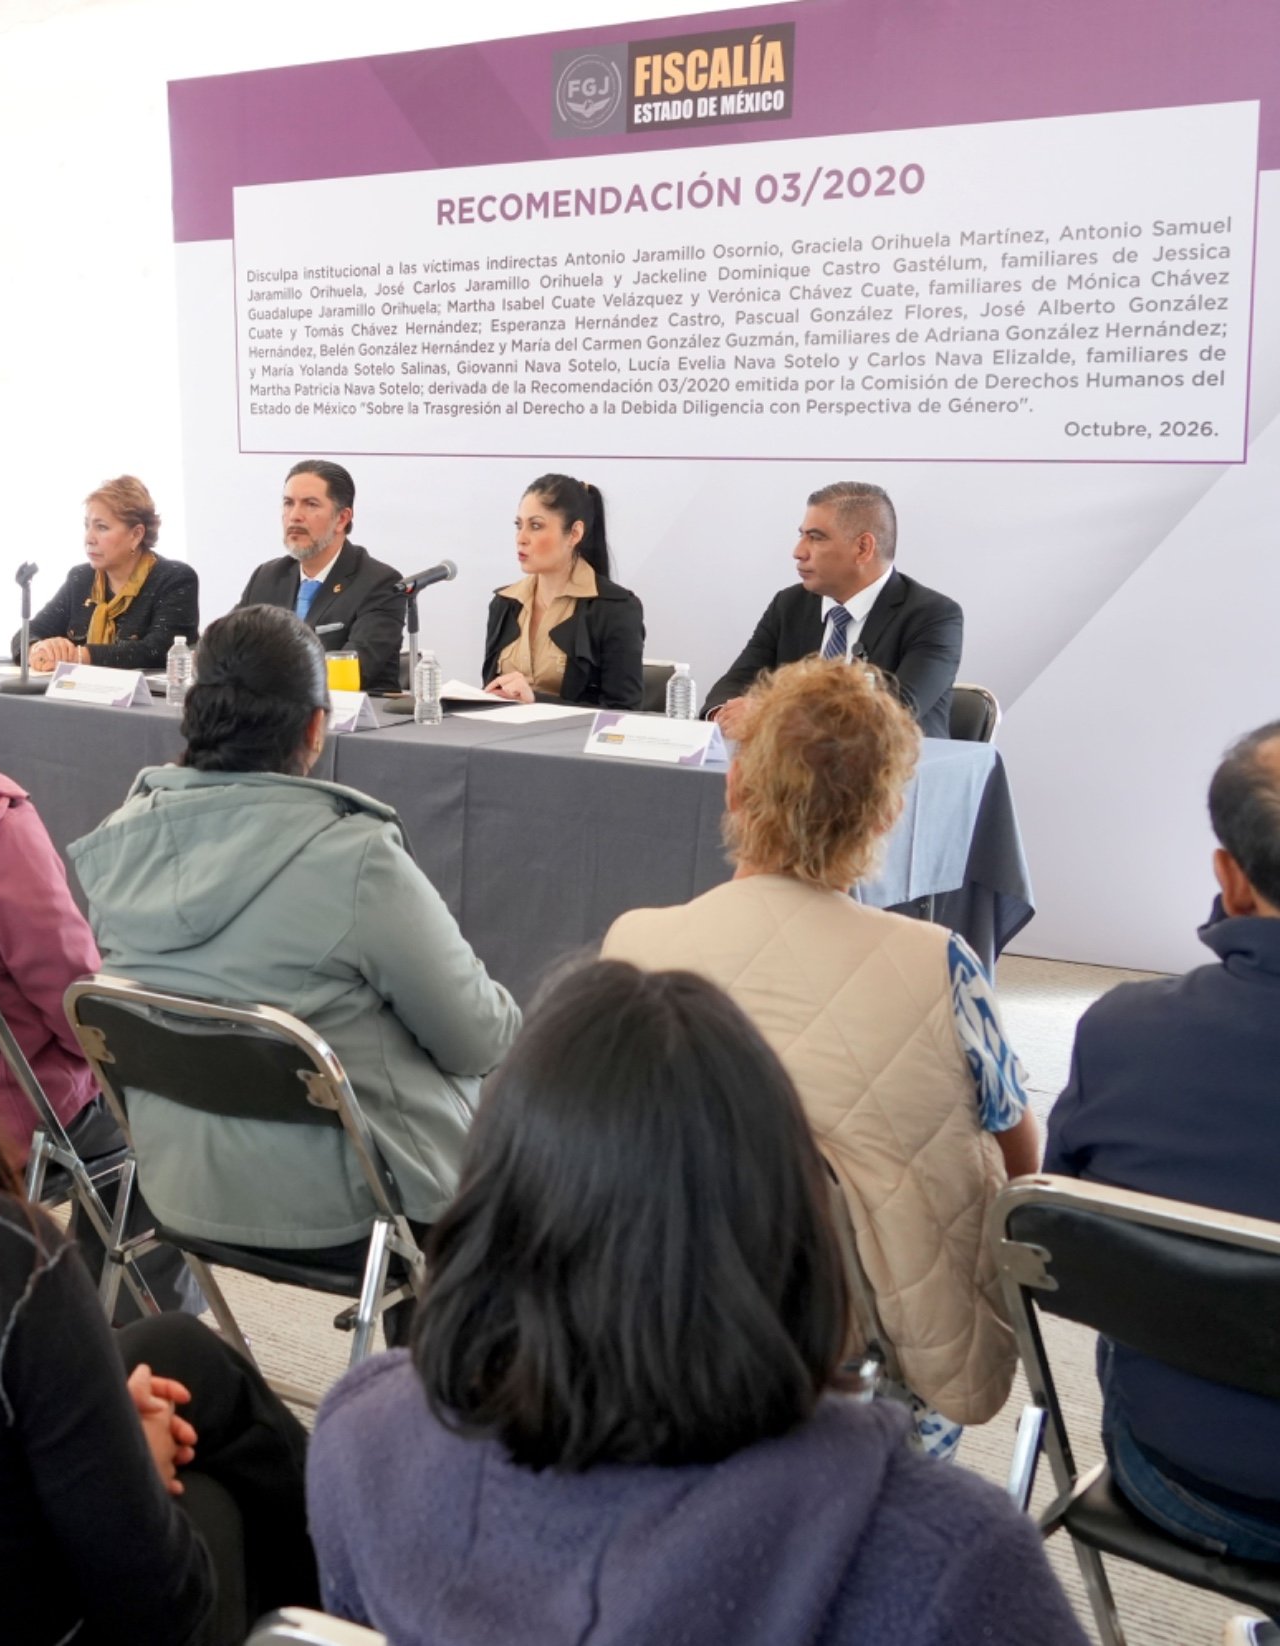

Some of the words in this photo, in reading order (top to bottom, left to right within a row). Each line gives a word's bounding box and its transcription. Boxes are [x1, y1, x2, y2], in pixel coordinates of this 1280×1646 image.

[634, 34, 785, 97] FISCALÍA
[567, 75, 610, 98] FGJ
[633, 98, 693, 124] ESTADO
[697, 96, 717, 117] DE
[721, 89, 785, 116] MÉXICO
[437, 171, 741, 226] RECOMENDACIÓN
[755, 163, 925, 207] 03/2020
[246, 267, 298, 283] Disculpa
[303, 262, 380, 279] institucional
[385, 264, 394, 275] a
[399, 261, 417, 275] las
[422, 258, 480, 273] víctimas
[486, 254, 557, 270] indirectas
[564, 249, 625, 266] Antonio
[631, 245, 705, 263] Jaramillo
[712, 240, 783, 259] Osornio,
[791, 235, 863, 255] Graciela
[871, 231, 950, 250] Orihuela
[960, 227, 1049, 246] Martínez,
[1059, 221, 1142, 240] Antonio
[1152, 215, 1231, 236] Samuel
[247, 286, 302, 302] Jaramillo
[309, 283, 367, 299] Orihuela,
[374, 281, 405, 296] José
[412, 279, 456, 295] Carlos
[464, 275, 530, 292] Jaramillo
[539, 271, 603, 288] Orihuela
[613, 274, 622, 288] y
[632, 267, 707, 285] Jackeline
[718, 263, 810, 281] Dominique
[822, 260, 880, 276] Castro
[892, 255, 987, 273] Gastélum,
[1001, 250, 1098, 268] familiares
[1112, 246, 1138, 263] de
[1152, 242, 1230, 262] Jessica
[247, 306, 312, 321] Guadalupe
[318, 302, 375, 318] Jaramillo
[380, 300, 441, 316] Orihuela;
[447, 298, 495, 313] Martha
[501, 295, 544, 311] Isabel
[551, 295, 595, 310] Cuate
[602, 291, 683, 308] Velázquez
[690, 292, 700, 307] y
[707, 286, 781, 303] Verónica
[789, 283, 852, 300] Chávez
[860, 282, 919, 298] Cuate,
[928, 277, 1022, 295] familiares
[1031, 274, 1056, 291] de
[1067, 272, 1140, 290] Mónica
[1150, 268, 1229, 287] Chávez
[248, 326, 283, 339] Cuate
[289, 328, 297, 340] y
[303, 323, 344, 338] Tomás
[350, 322, 398, 336] Chávez
[405, 319, 482, 335] Hernández;
[490, 318, 566, 334] Esperanza
[574, 313, 658, 330] Hernández
[667, 311, 724, 328] Castro,
[735, 307, 799, 325] Pascual
[809, 305, 893, 322] González
[905, 303, 967, 320] Flores,
[979, 299, 1025, 317] José
[1037, 298, 1115, 315] Alberto
[1128, 293, 1228, 313] González
[248, 344, 316, 359] Hernández,
[319, 343, 355, 356] Belén
[357, 341, 418, 356] González
[420, 339, 495, 354] Hernández
[498, 341, 507, 355] y
[511, 337, 550, 352] María
[554, 336, 577, 351] del
[581, 336, 642, 351] Carmen
[646, 333, 721, 349] González
[724, 331, 799, 347] Guzmán,
[804, 328, 890, 345] familiares
[895, 327, 919, 343] de
[924, 325, 999, 342] Adriana
[1005, 322, 1099, 341] González
[1105, 319, 1227, 338] Hernández;
[249, 368, 256, 379] y
[261, 363, 294, 377] María
[299, 362, 349, 376] Yolanda
[353, 361, 395, 376] Sotelo
[400, 361, 450, 376] Salinas,
[456, 359, 518, 374] Giovanni
[524, 359, 561, 373] Nava
[567, 357, 620, 373] Sotelo,
[628, 356, 670, 371] Lucía
[677, 354, 726, 370] Evelia
[734, 354, 775, 369] Nava
[784, 352, 840, 369] Sotelo
[848, 355, 858, 371] y
[867, 351, 926, 367] Carlos
[935, 350, 982, 366] Nava
[992, 347, 1075, 366] Elizalde,
[1086, 345, 1188, 363] familiares
[1198, 344, 1226, 361] de
[249, 383, 291, 396] Martha
[294, 382, 340, 396] Patricia
[343, 382, 375, 395] Nava
[378, 381, 424, 397] Sotelo;
[427, 380, 488, 394] derivada
[491, 379, 509, 394] de
[513, 379, 526, 394] la
[530, 378, 653, 394] Recomendación
[657, 376, 730, 394] 03/2020
[734, 376, 799, 392] emitida
[804, 379, 835, 393] por
[840, 375, 855, 390] la
[860, 373, 948, 391] Comisión
[954, 373, 978, 389] de
[985, 372, 1079, 389] Derechos
[1086, 371, 1184, 388] Humanos
[1191, 369, 1224, 386] del
[250, 401, 291, 415] Estado
[294, 401, 310, 414] de
[313, 401, 357, 415] México
[407, 401, 419, 414] la
[422, 400, 501, 417] Trasgresión
[505, 399, 518, 414] al
[522, 400, 585, 414] Derecho
[589, 403, 598, 414] a
[602, 399, 616, 414] la
[620, 399, 677, 414] Debida
[682, 398, 764, 417] Diligencia
[769, 401, 800, 414] con
[806, 397, 911, 416] Perspectiva
[917, 397, 941, 413] de
[1064, 420, 1151, 439] Octubre,
[1158, 420, 1218, 437] 2026.
